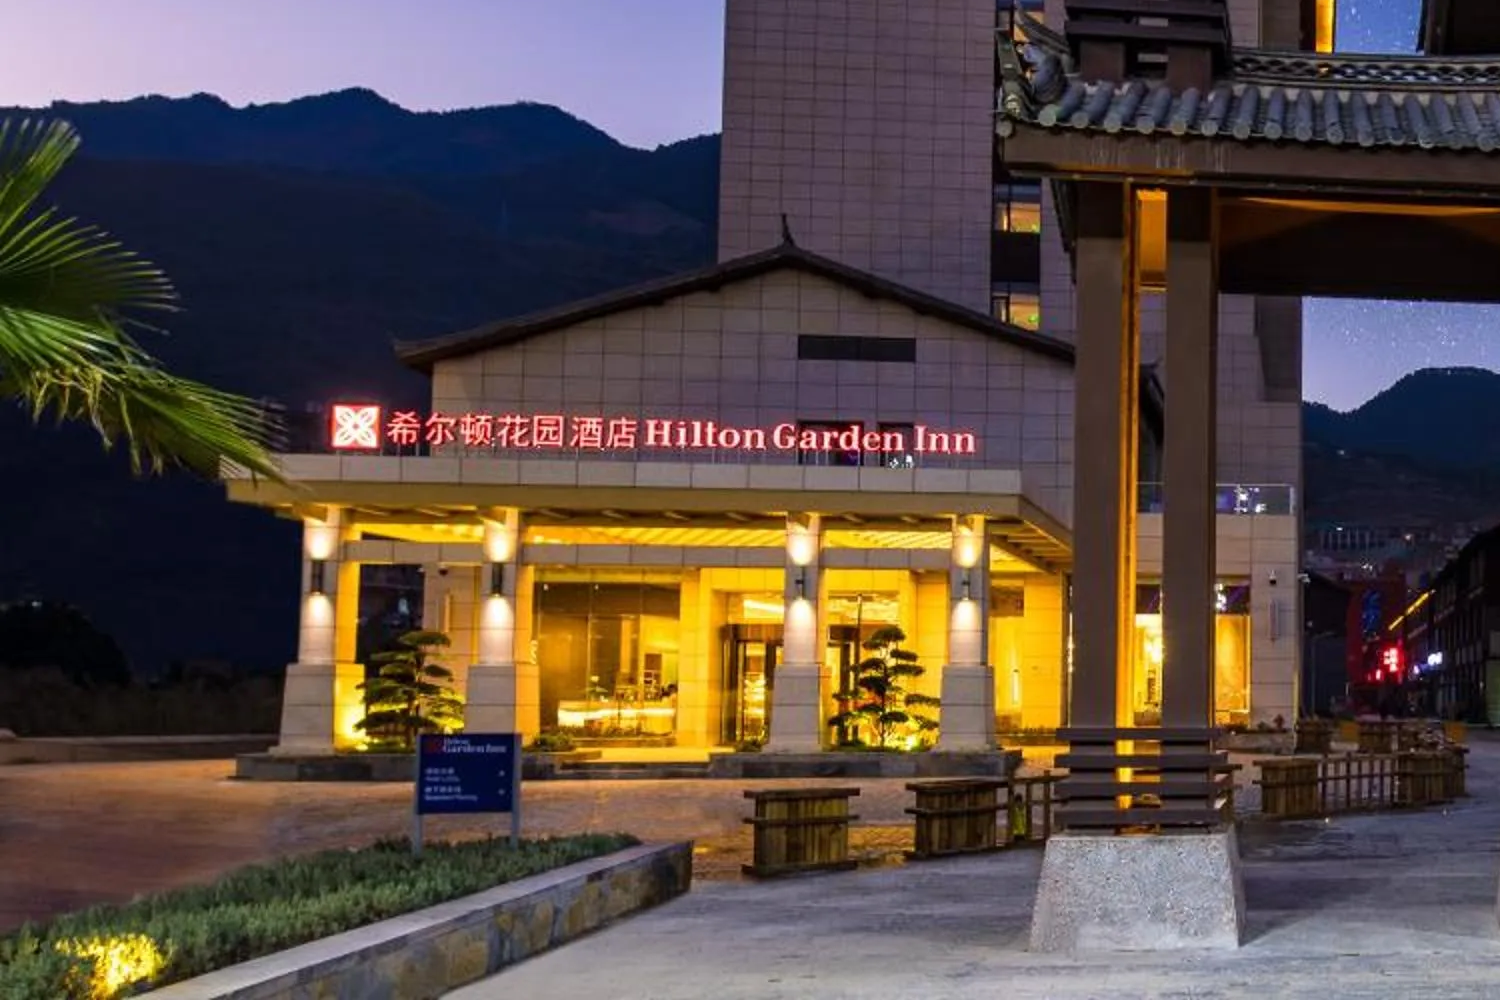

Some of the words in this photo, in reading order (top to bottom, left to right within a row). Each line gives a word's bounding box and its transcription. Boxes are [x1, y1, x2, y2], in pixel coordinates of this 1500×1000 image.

[386, 410, 637, 449] 希尔顿花园酒店
[644, 418, 766, 449] Hilton
[773, 422, 904, 452] Garden
[913, 425, 977, 454] Inn
